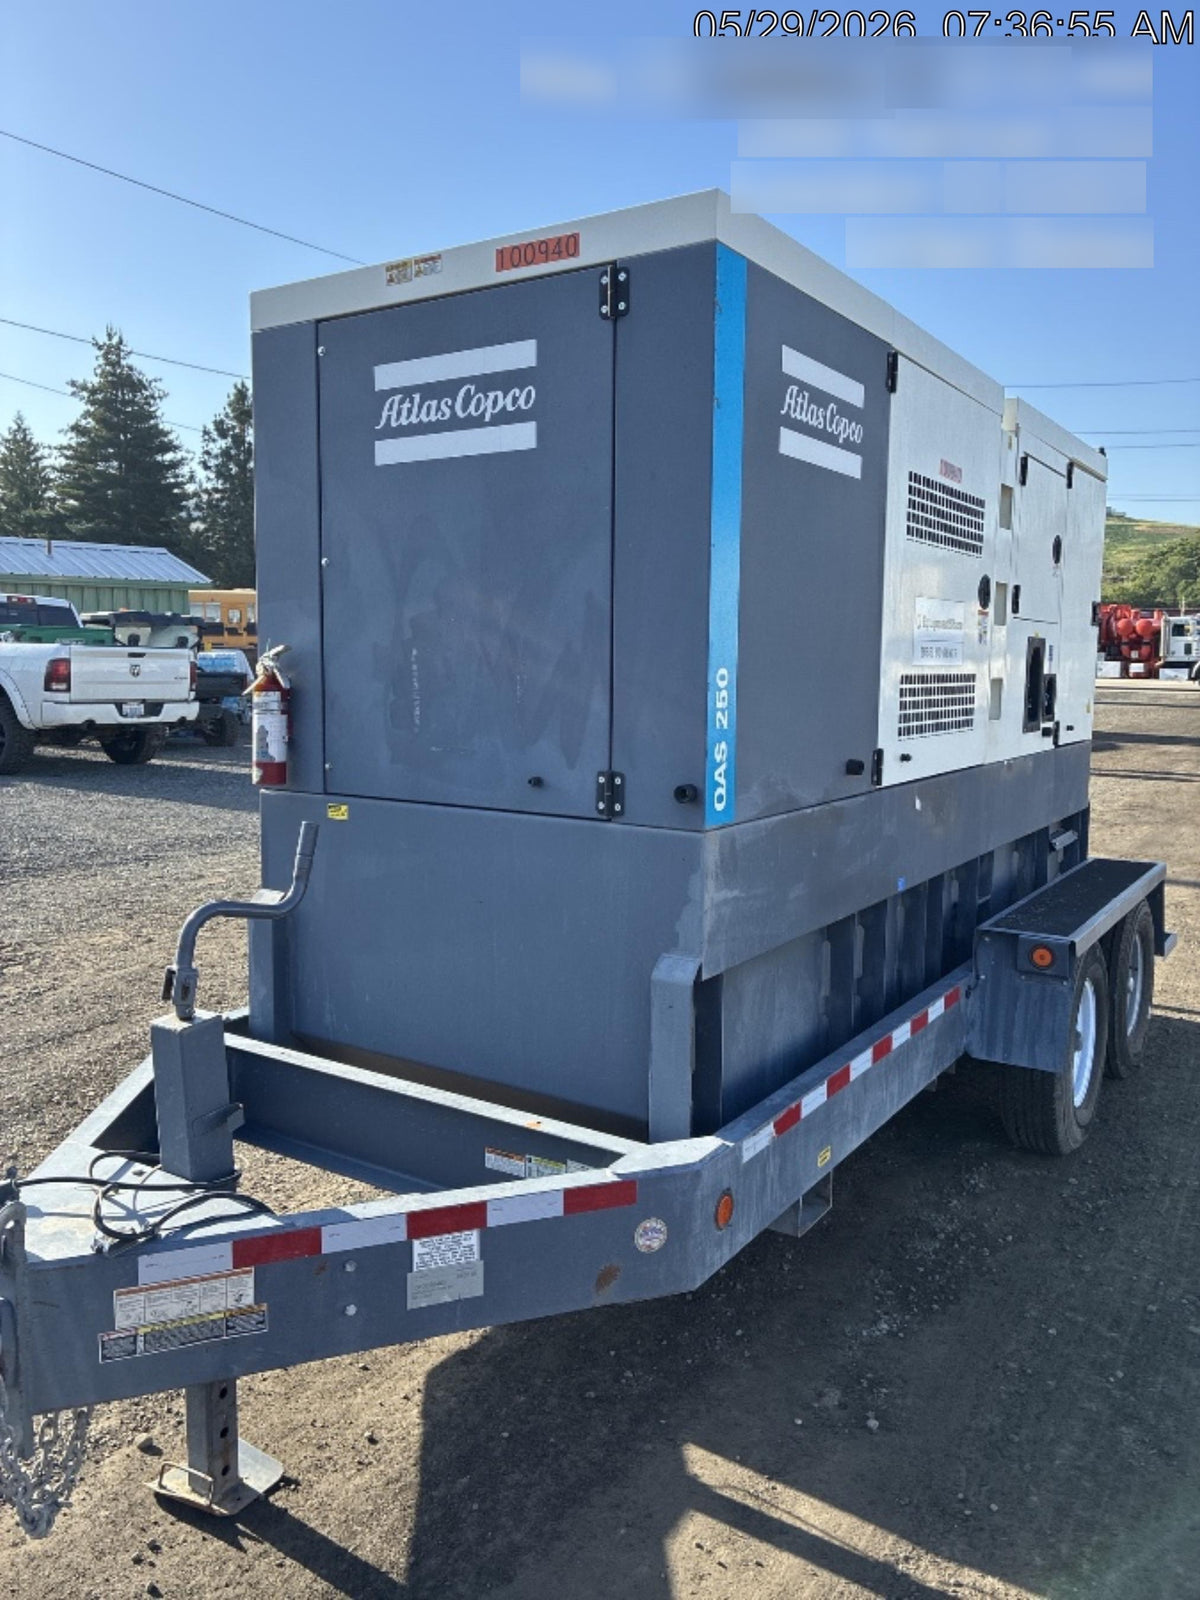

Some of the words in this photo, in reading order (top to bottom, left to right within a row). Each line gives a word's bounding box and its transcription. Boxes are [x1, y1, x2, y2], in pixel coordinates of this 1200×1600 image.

[499, 233, 578, 270] 100940
[715, 667, 729, 730] 250
[713, 740, 728, 812] QAS
